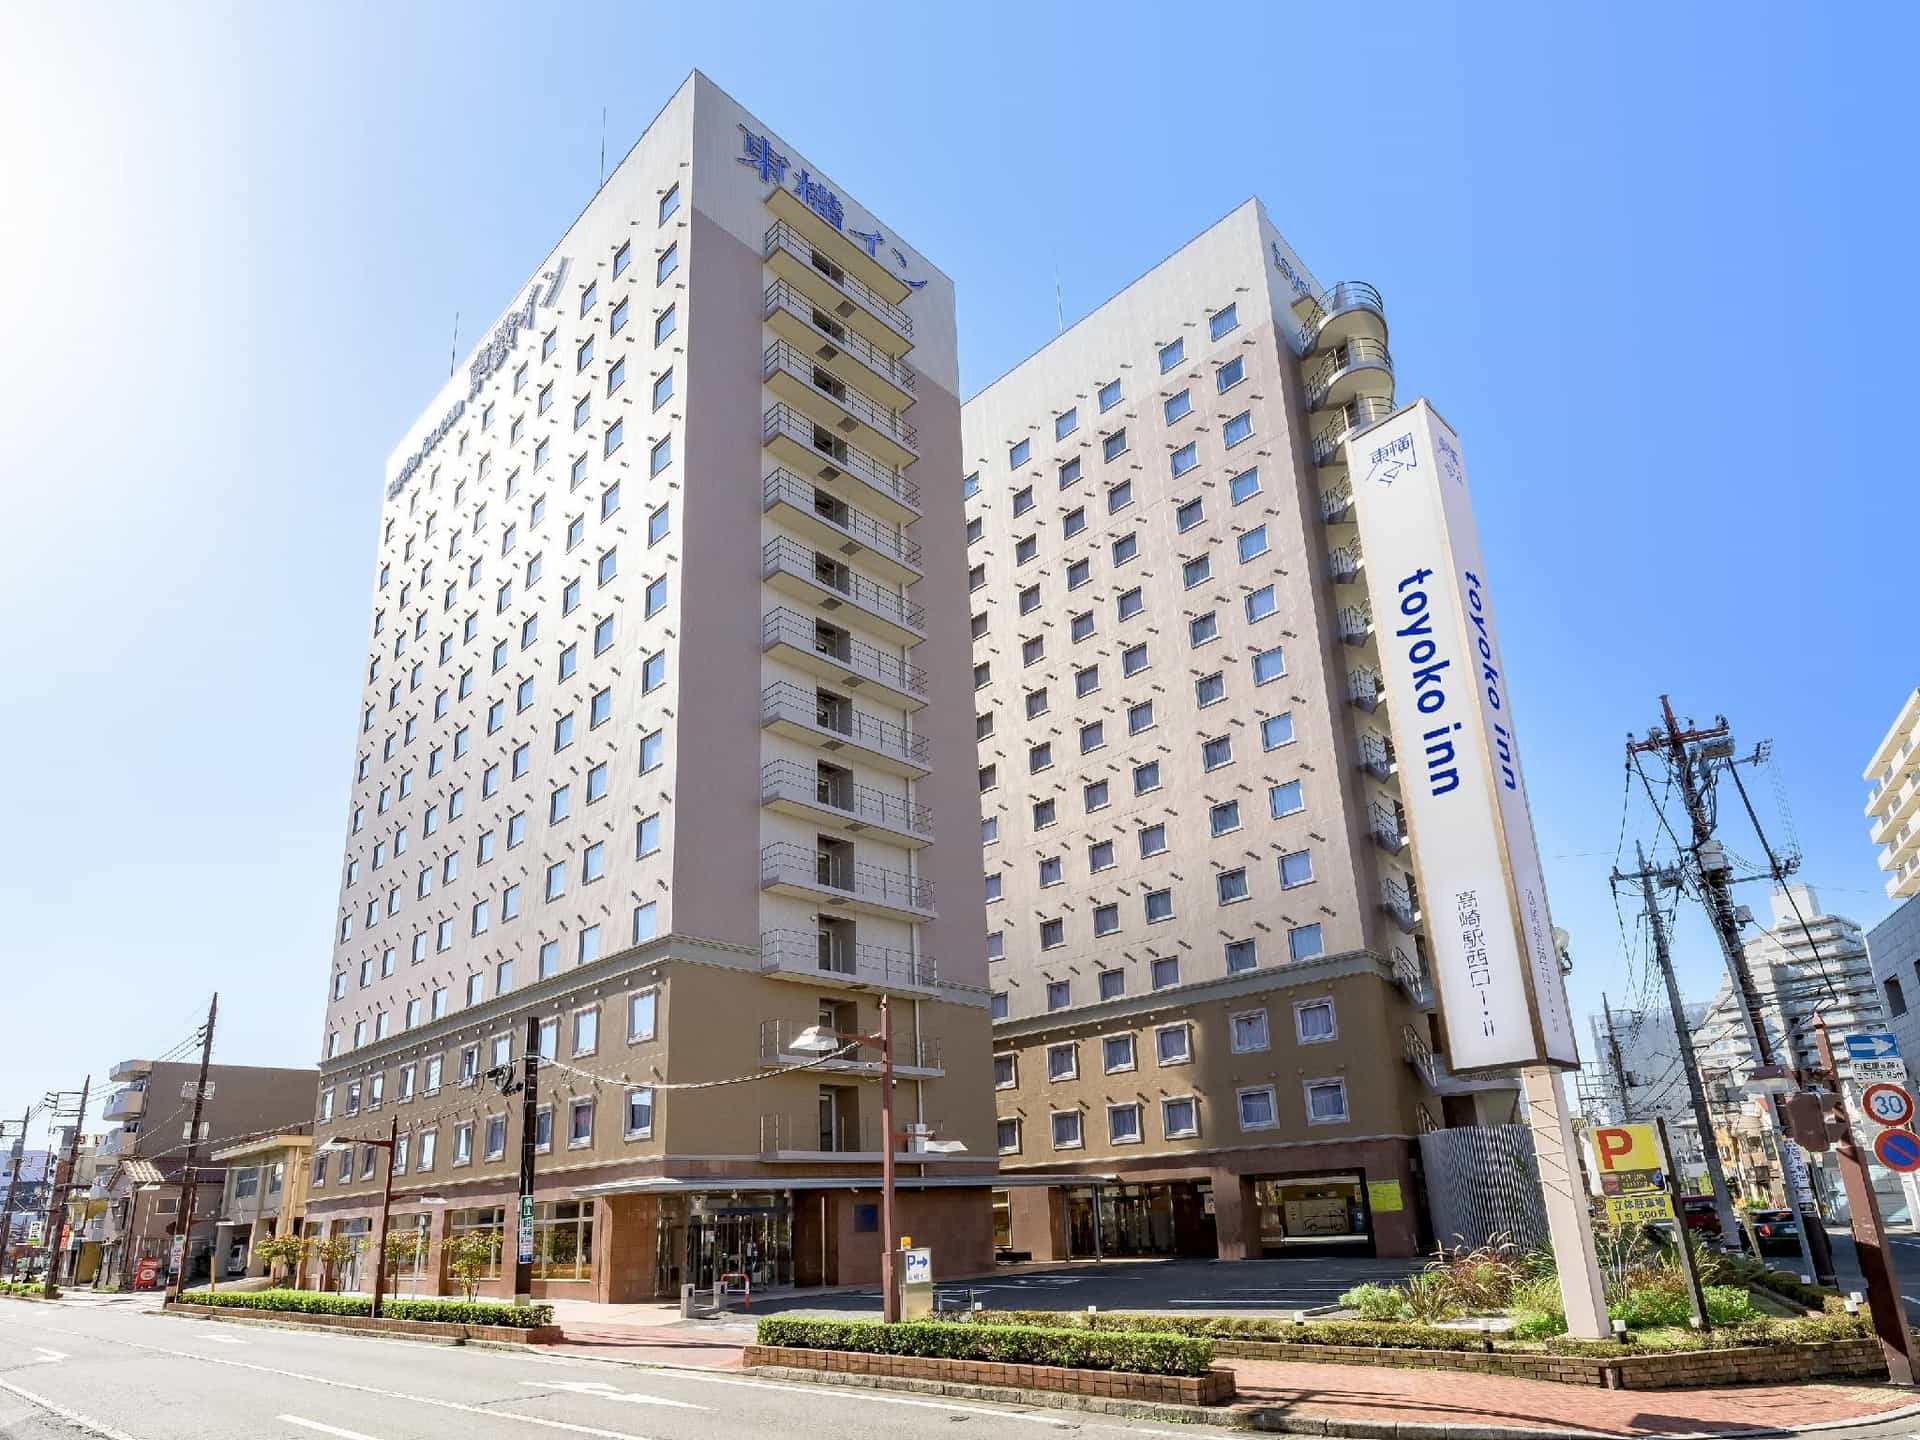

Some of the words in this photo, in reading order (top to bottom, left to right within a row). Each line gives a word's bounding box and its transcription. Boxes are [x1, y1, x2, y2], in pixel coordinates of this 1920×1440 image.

[1396, 568, 1450, 714] toyoko
[1423, 722, 1462, 796] inn
[1465, 571, 1499, 711] toyoko
[1493, 722, 1517, 791] inn
[1874, 1095, 1904, 1115] 30
[1596, 1128, 1633, 1170] P
[1638, 1209, 1667, 1219] 500円
[907, 1255, 916, 1271] P
